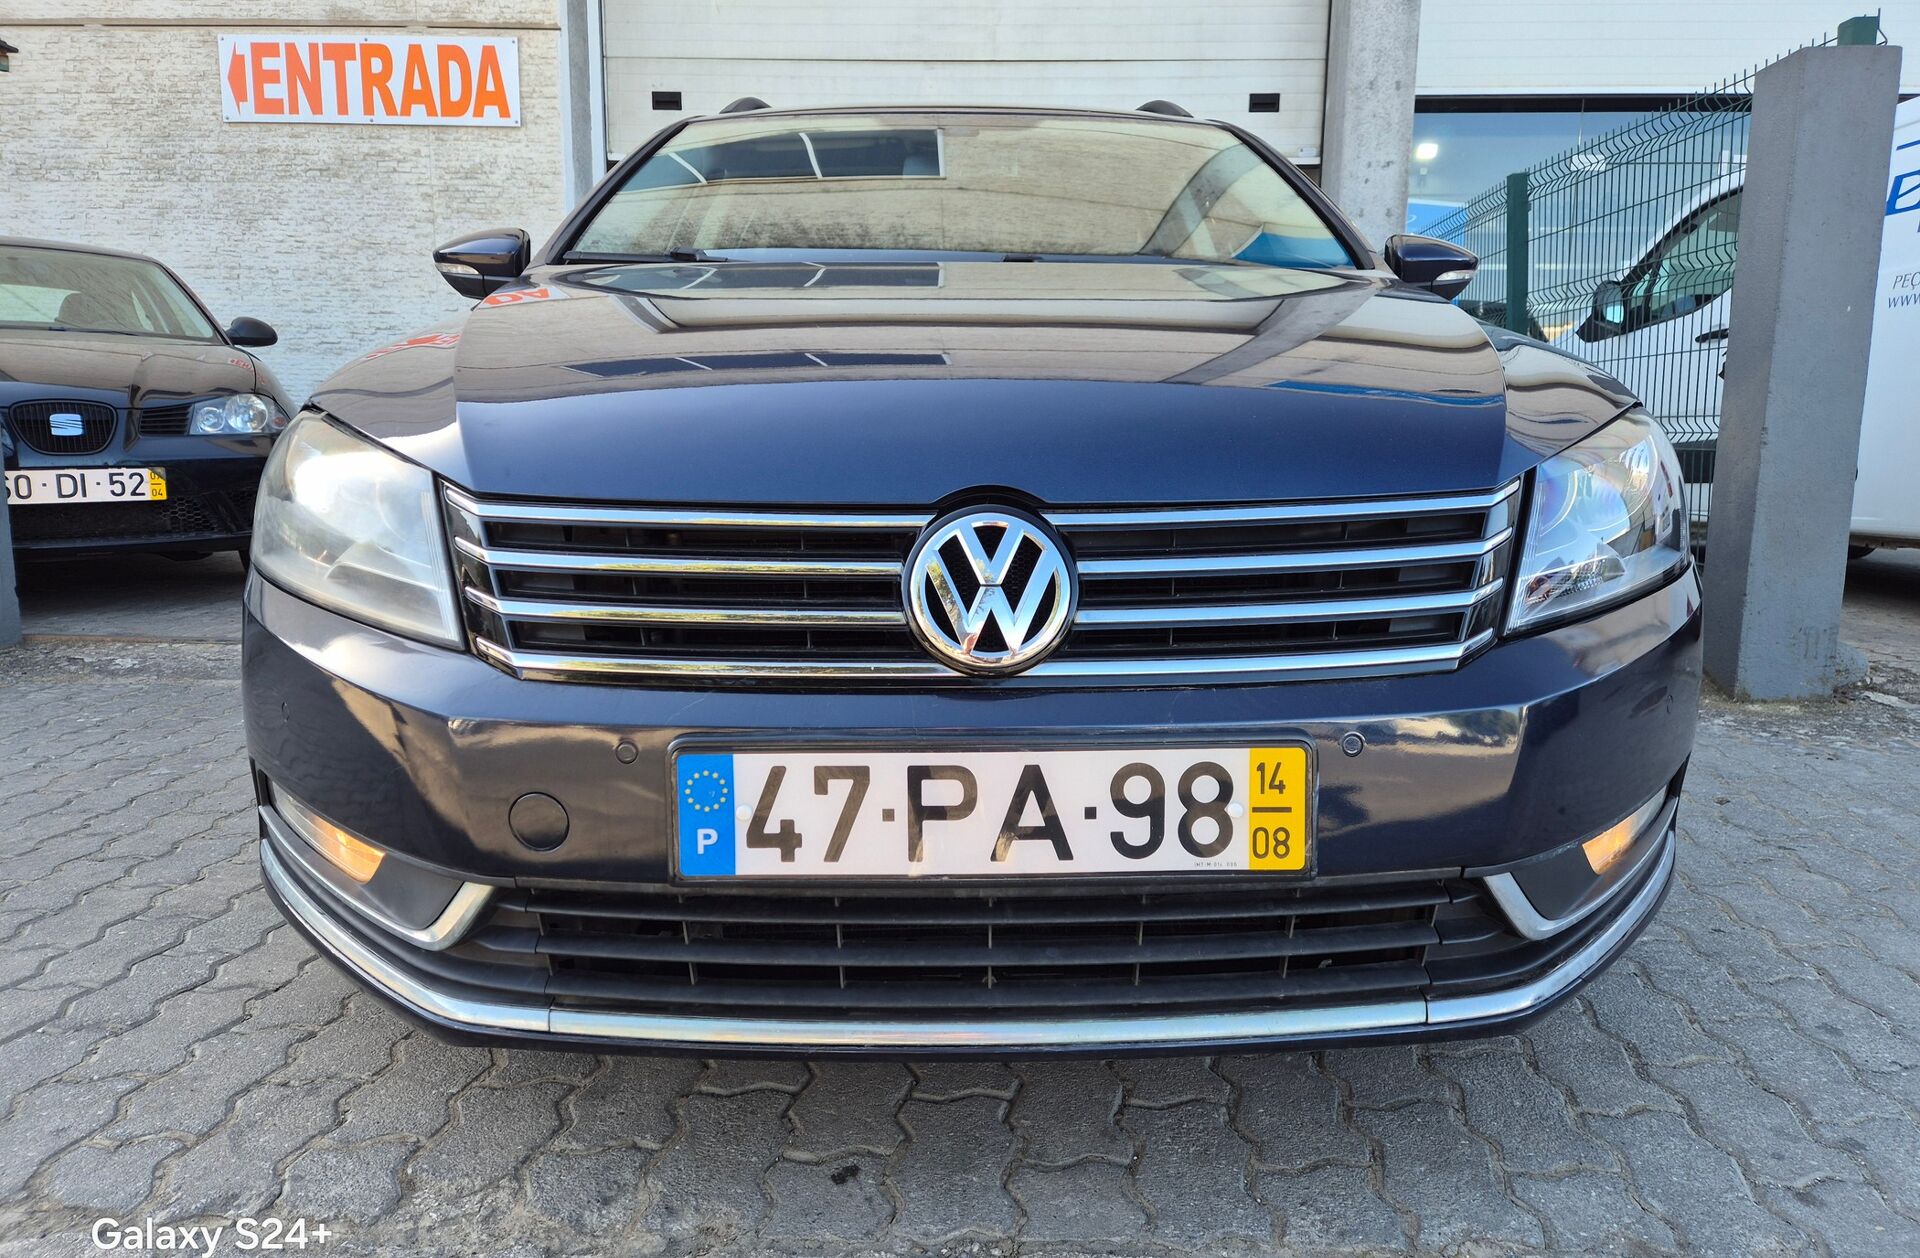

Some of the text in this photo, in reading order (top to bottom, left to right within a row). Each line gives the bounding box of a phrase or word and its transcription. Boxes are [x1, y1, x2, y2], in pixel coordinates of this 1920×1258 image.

[250, 42, 511, 118] ENTRADA
[152, 488, 163, 497] 04
[1256, 761, 1286, 795] 14
[697, 828, 719, 855] P
[1252, 826, 1291, 859] 08
